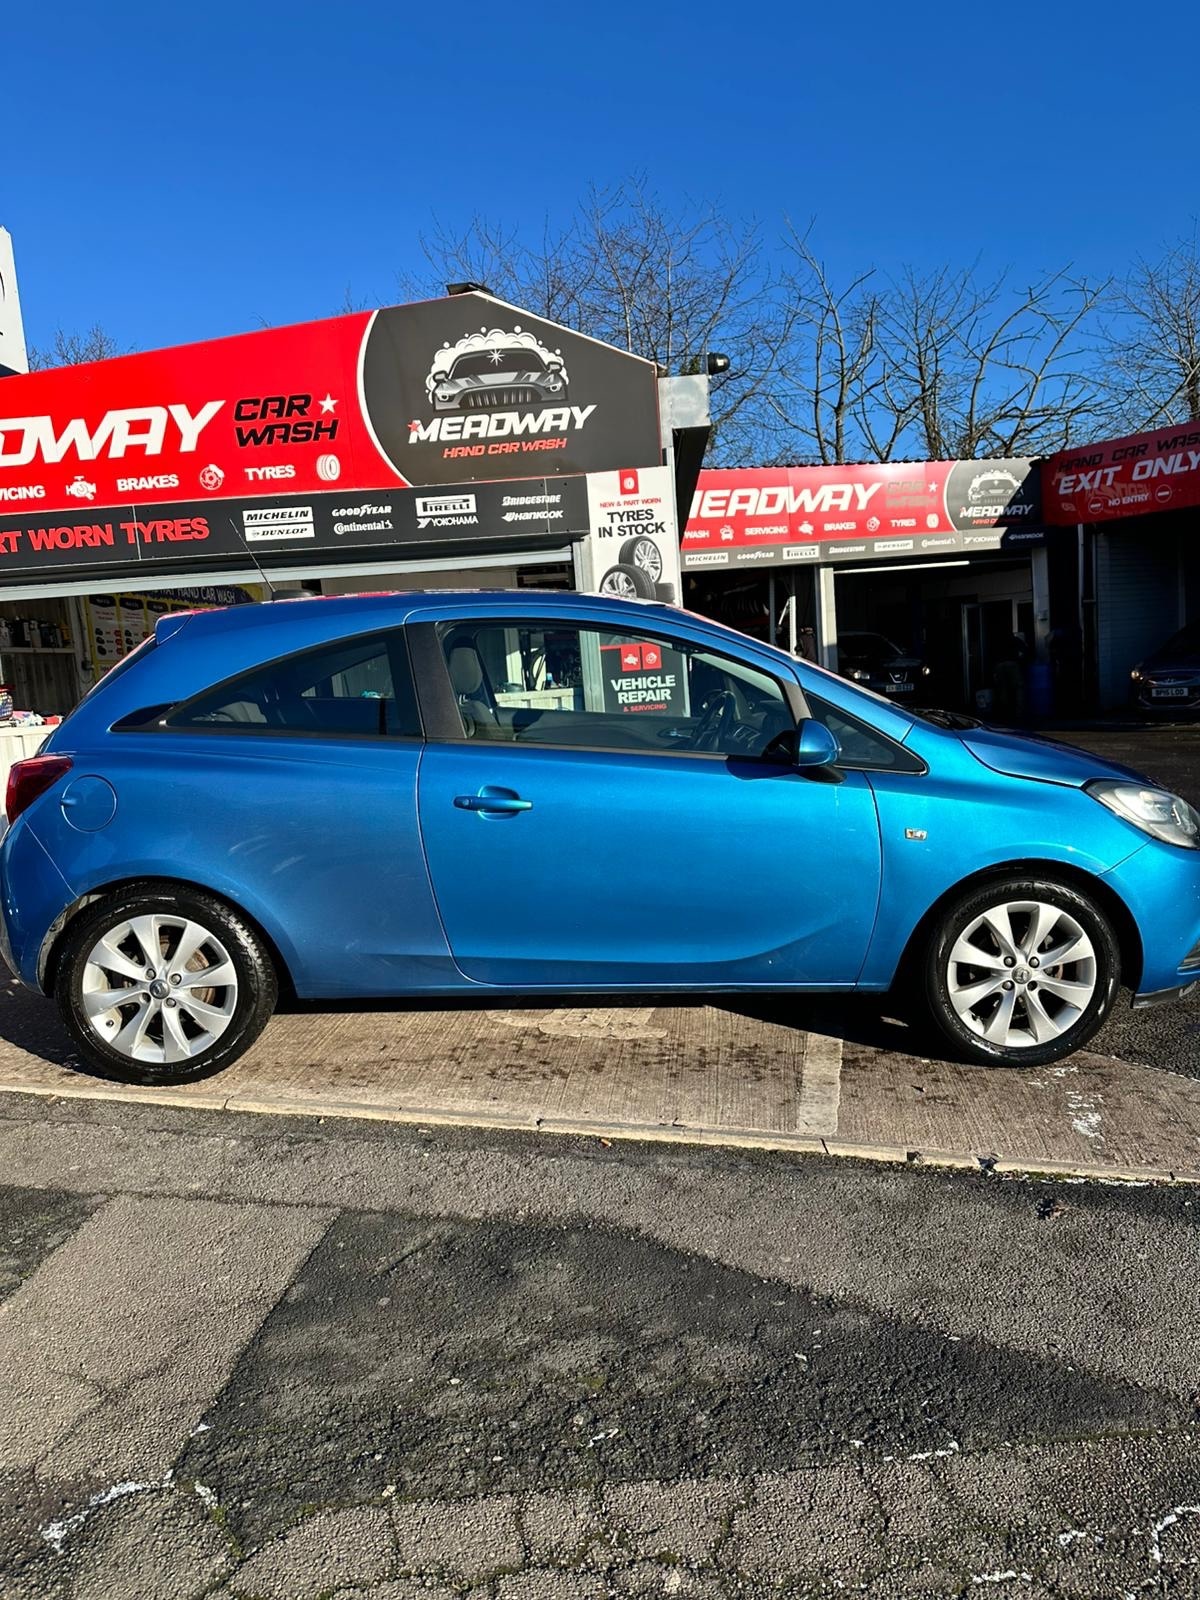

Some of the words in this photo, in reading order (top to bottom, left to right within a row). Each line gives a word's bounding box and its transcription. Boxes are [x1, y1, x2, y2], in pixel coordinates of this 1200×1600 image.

[234, 393, 312, 421] CAR
[408, 404, 597, 444] MEADWAY
[235, 419, 339, 448] WASH
[442, 445, 486, 458] HAND
[488, 442, 521, 455] CAR
[522, 438, 567, 452] WASH
[1112, 442, 1149, 461] CAR
[1156, 432, 1200, 452] WAS
[116, 474, 180, 492] BRAKES
[244, 465, 297, 481] TYRES
[1058, 465, 1122, 495] EXIT
[1132, 450, 1200, 481] ONLY
[421, 498, 470, 512] PIRELLI
[502, 494, 561, 506] BRIDGESTONE
[641, 497, 662, 505] WORN
[1108, 498, 1121, 507] NO
[1122, 492, 1150, 505] ENTRY
[246, 510, 310, 521] MICHELIN
[331, 504, 392, 517] GOODYEAR
[607, 508, 654, 523] TYRES
[959, 504, 1034, 519] MEADWAY
[333, 520, 386, 535] Continental
[431, 515, 479, 527] YOKOHAMA
[684, 530, 710, 539] WASH
[744, 525, 788, 536] SERVICING
[823, 521, 857, 532] BRAKES
[890, 518, 917, 528] TYRES
[28, 524, 114, 551] WORN
[120, 517, 210, 544] TYRES
[261, 527, 308, 536] DUNLOP
[598, 526, 613, 538] IN
[617, 521, 666, 537] STOCK
[687, 555, 727, 563] MICHELIN
[217, 589, 236, 604] WASH
[610, 674, 676, 691] VEHICLE
[617, 689, 672, 704] REPAIR
[630, 703, 667, 712] SERVICING
